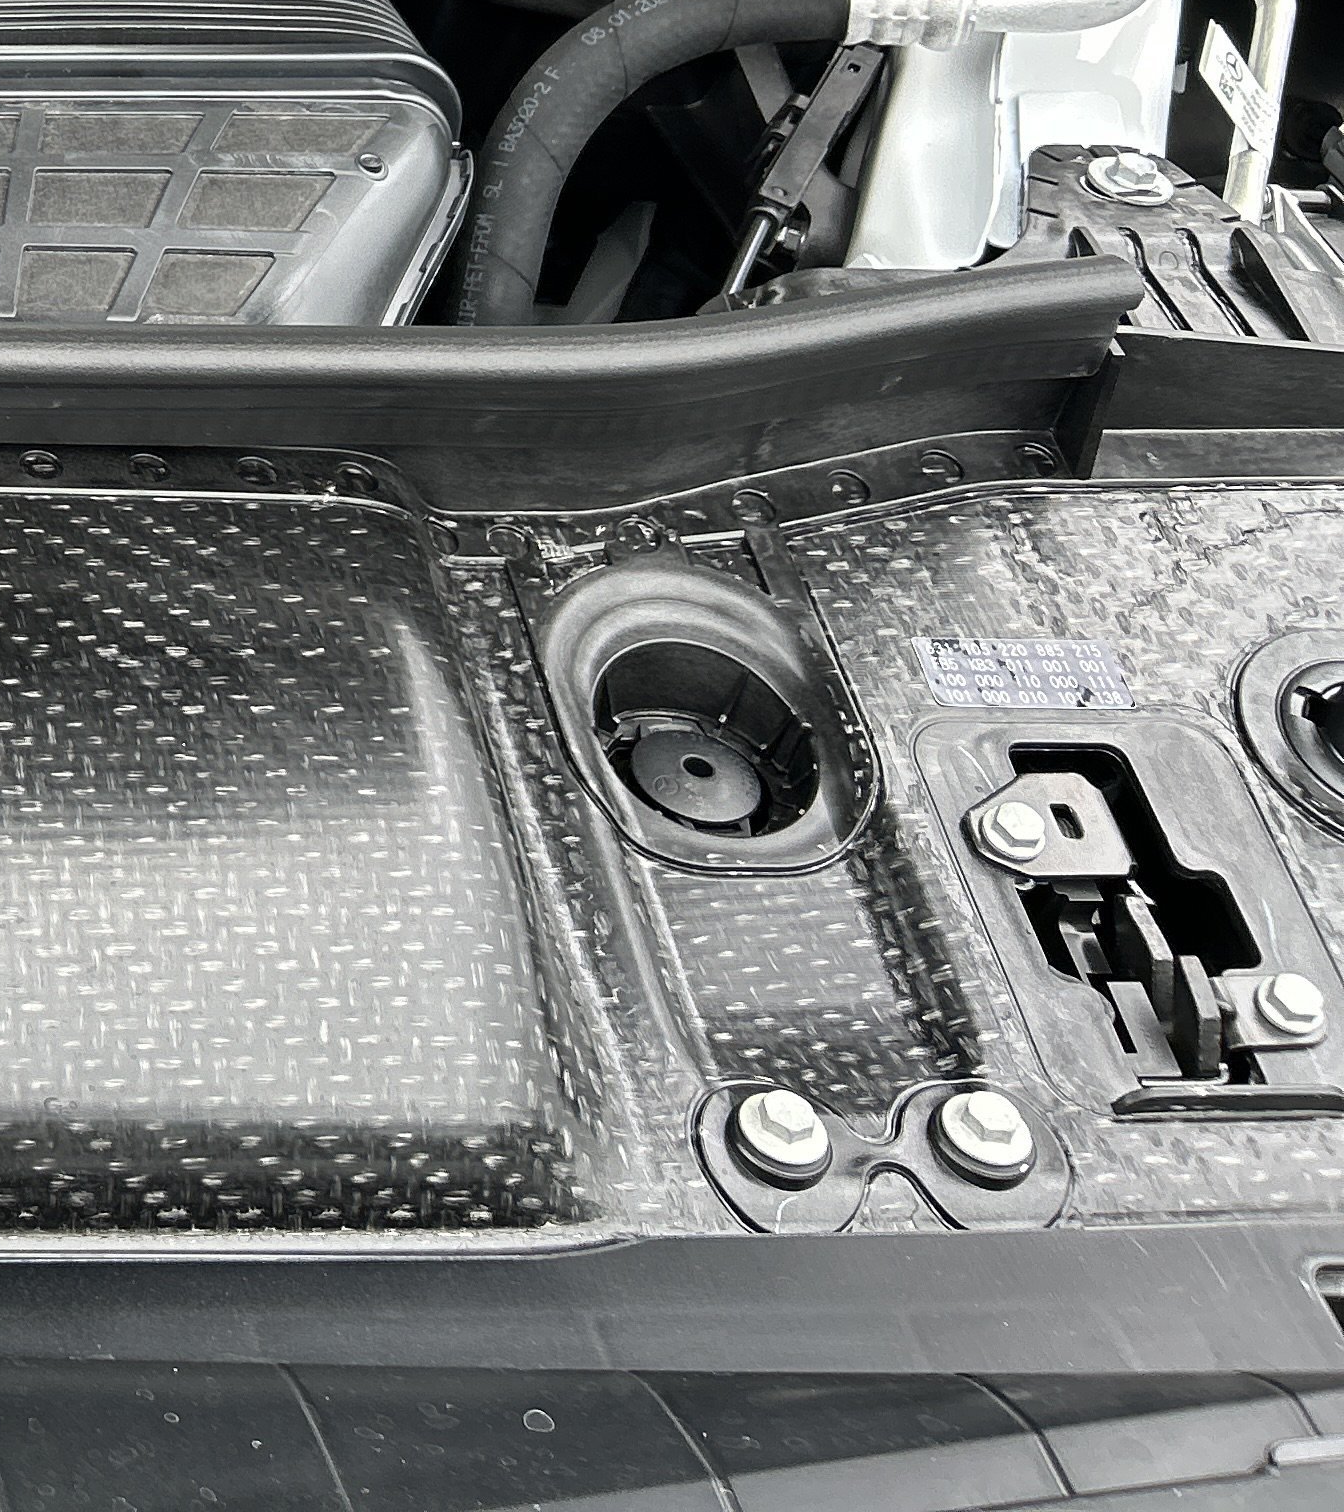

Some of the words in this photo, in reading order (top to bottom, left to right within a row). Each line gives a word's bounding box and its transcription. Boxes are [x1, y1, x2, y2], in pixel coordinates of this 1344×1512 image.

[999, 643, 1028, 657] 220
[1071, 644, 1101, 658] 215
[1006, 659, 1033, 672] 011
[1042, 660, 1070, 673] 001
[1079, 660, 1108, 673] 001
[939, 674, 967, 687] 100
[975, 674, 1004, 688] 000
[1014, 675, 1041, 688] 110
[1049, 675, 1078, 689] 000
[1089, 676, 1116, 689] 111
[946, 689, 973, 703] 101
[981, 690, 1011, 704] 000
[1019, 690, 1048, 704] 010
[1095, 691, 1124, 705] 138
